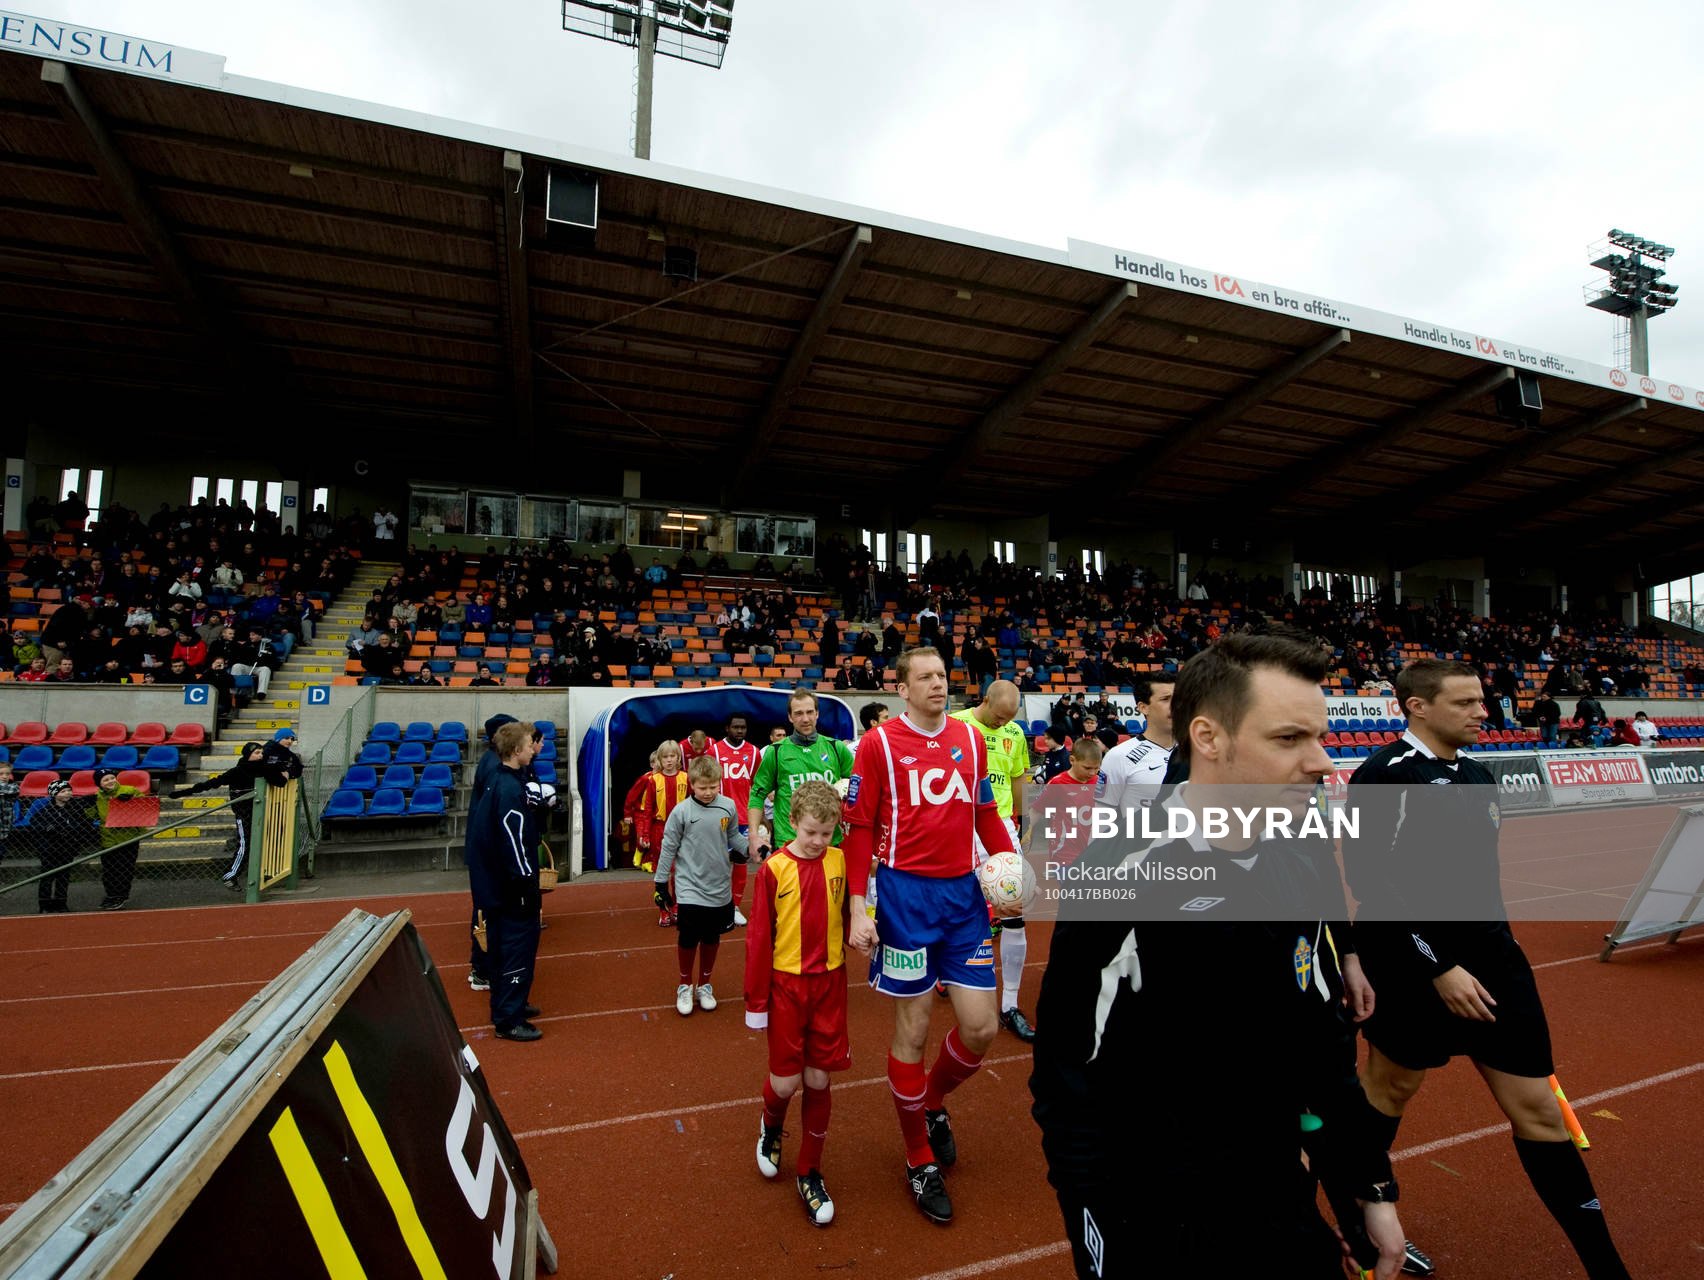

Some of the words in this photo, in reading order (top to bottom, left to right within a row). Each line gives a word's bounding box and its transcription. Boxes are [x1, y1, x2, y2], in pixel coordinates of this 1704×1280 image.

[1, 16, 174, 73] ENSUM
[1115, 254, 1174, 282] Handla
[1180, 269, 1208, 289] hos
[1214, 274, 1245, 298] ICA
[1252, 290, 1270, 304] en
[1274, 290, 1299, 311] bra
[1304, 300, 1350, 322] affär...
[1404, 322, 1448, 344] Handla
[1451, 332, 1470, 350] hos
[1475, 336, 1498, 356] ICA
[1503, 348, 1516, 361] en
[1519, 349, 1537, 365] bra
[1540, 357, 1574, 374] affär...
[355, 460, 368, 475] C
[9, 476, 18, 486] C
[286, 496, 295, 507] C
[190, 688, 204, 702] C
[312, 688, 326, 702] D
[1361, 702, 1382, 716] hos
[1386, 700, 1402, 717] IC
[724, 763, 750, 780] ICA
[1550, 763, 1598, 784] TEAM
[1599, 762, 1641, 782] SPORTIA
[908, 768, 972, 806] ICA
[885, 948, 924, 970] EURO
